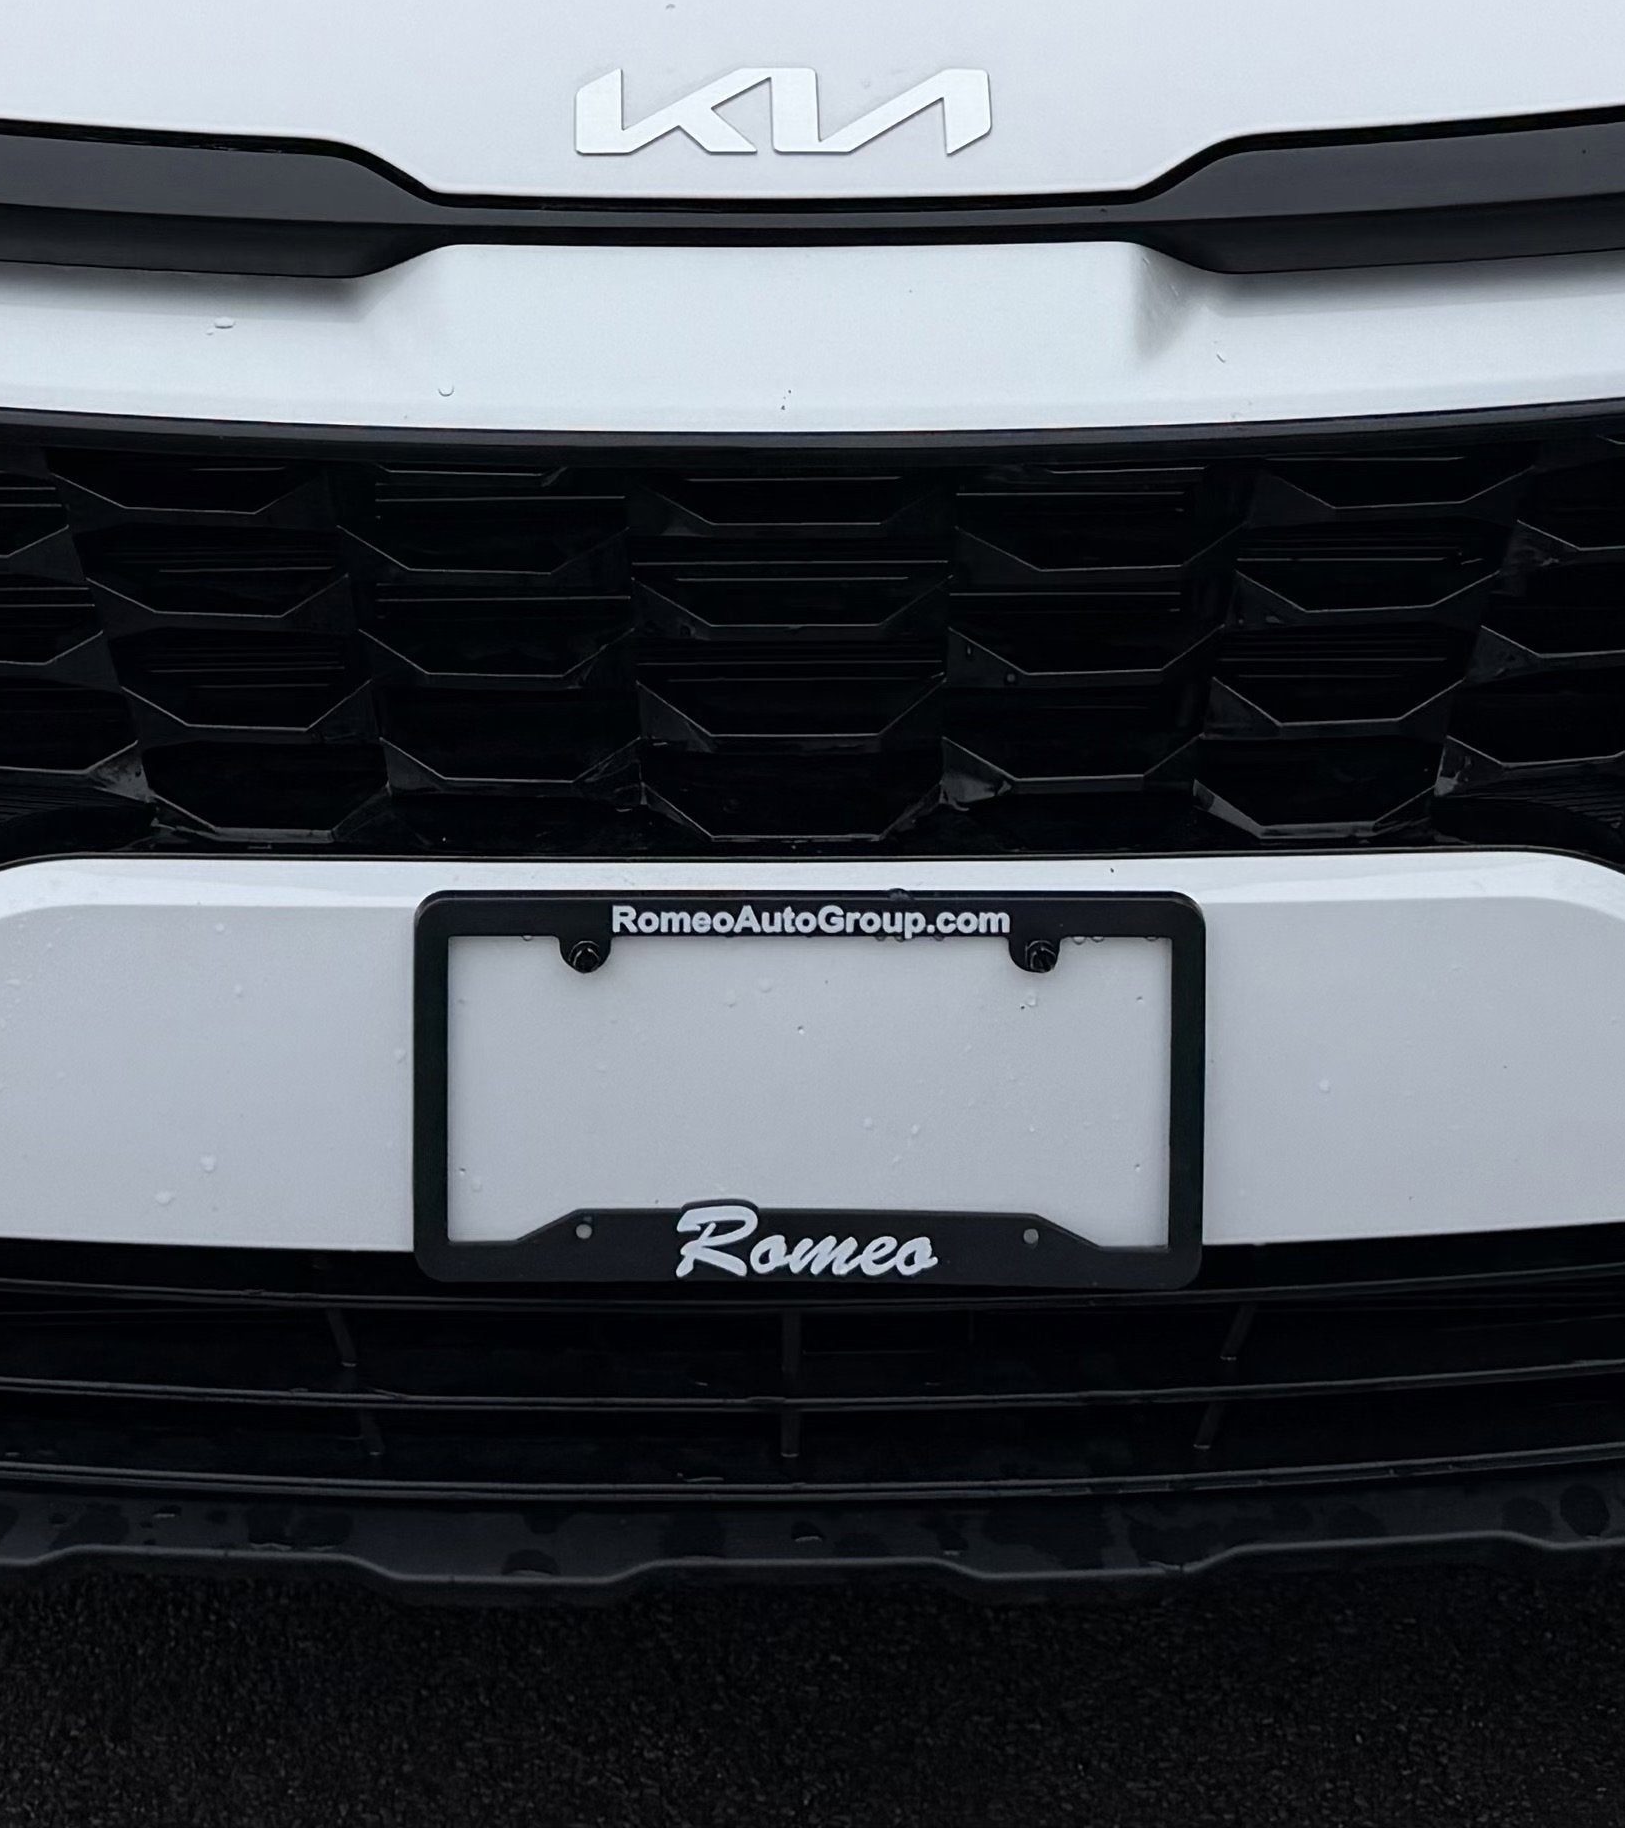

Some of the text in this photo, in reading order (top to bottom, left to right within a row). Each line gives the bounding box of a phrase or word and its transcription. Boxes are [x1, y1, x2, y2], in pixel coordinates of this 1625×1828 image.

[576, 67, 992, 157] KIA
[611, 904, 1011, 939] RomeoAutoGroup.com
[675, 1204, 939, 1279] Romeo
